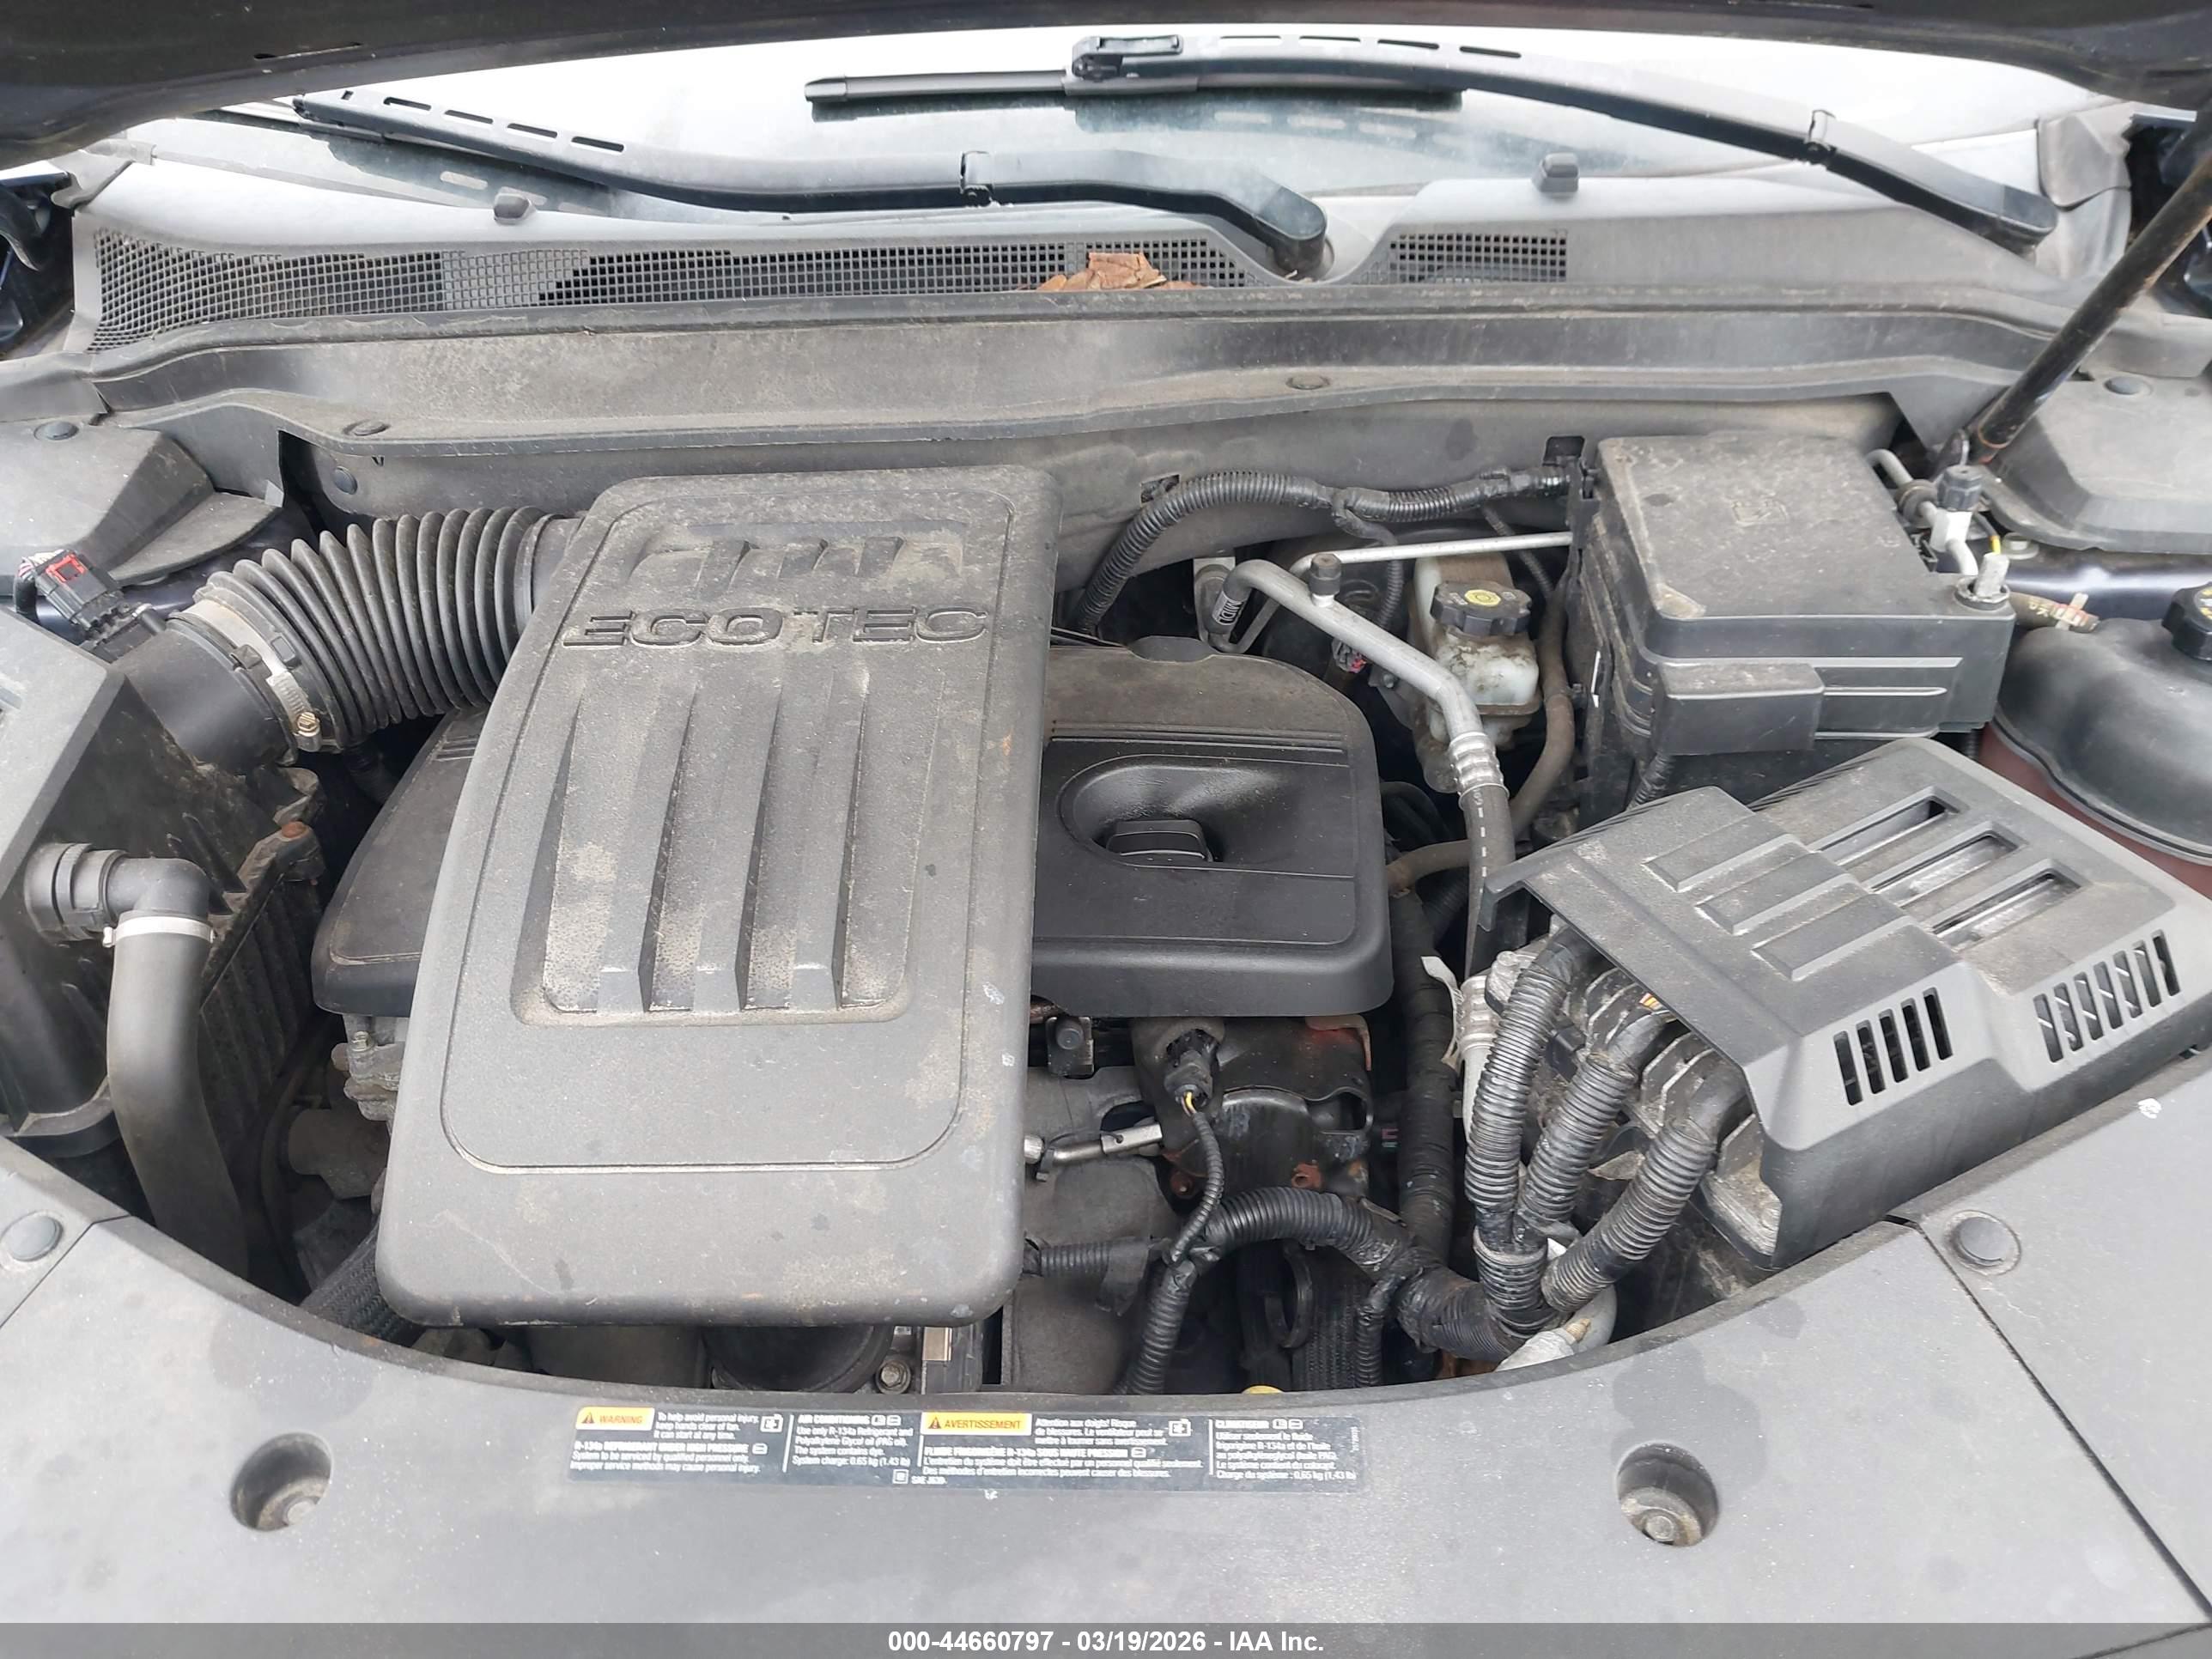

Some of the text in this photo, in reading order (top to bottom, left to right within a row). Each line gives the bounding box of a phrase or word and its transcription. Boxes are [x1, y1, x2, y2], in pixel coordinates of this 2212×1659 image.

[562, 606, 989, 650] ECOTEC
[599, 1415, 643, 1424] WARNING
[705, 1413, 736, 1423] personal
[945, 1420, 1021, 1429] AVERTISSEMENT
[703, 1432, 716, 1441] any
[812, 1427, 827, 1437] only
[830, 1427, 856, 1436] R-134a
[573, 1450, 599, 1461] System
[601, 1451, 609, 1460] to
[611, 1452, 619, 1461] be
[810, 1447, 836, 1455] system
[793, 1456, 819, 1465] System
[869, 1457, 878, 1467] kg
[665, 1463, 680, 1472] may
[705, 1462, 737, 1473] personal
